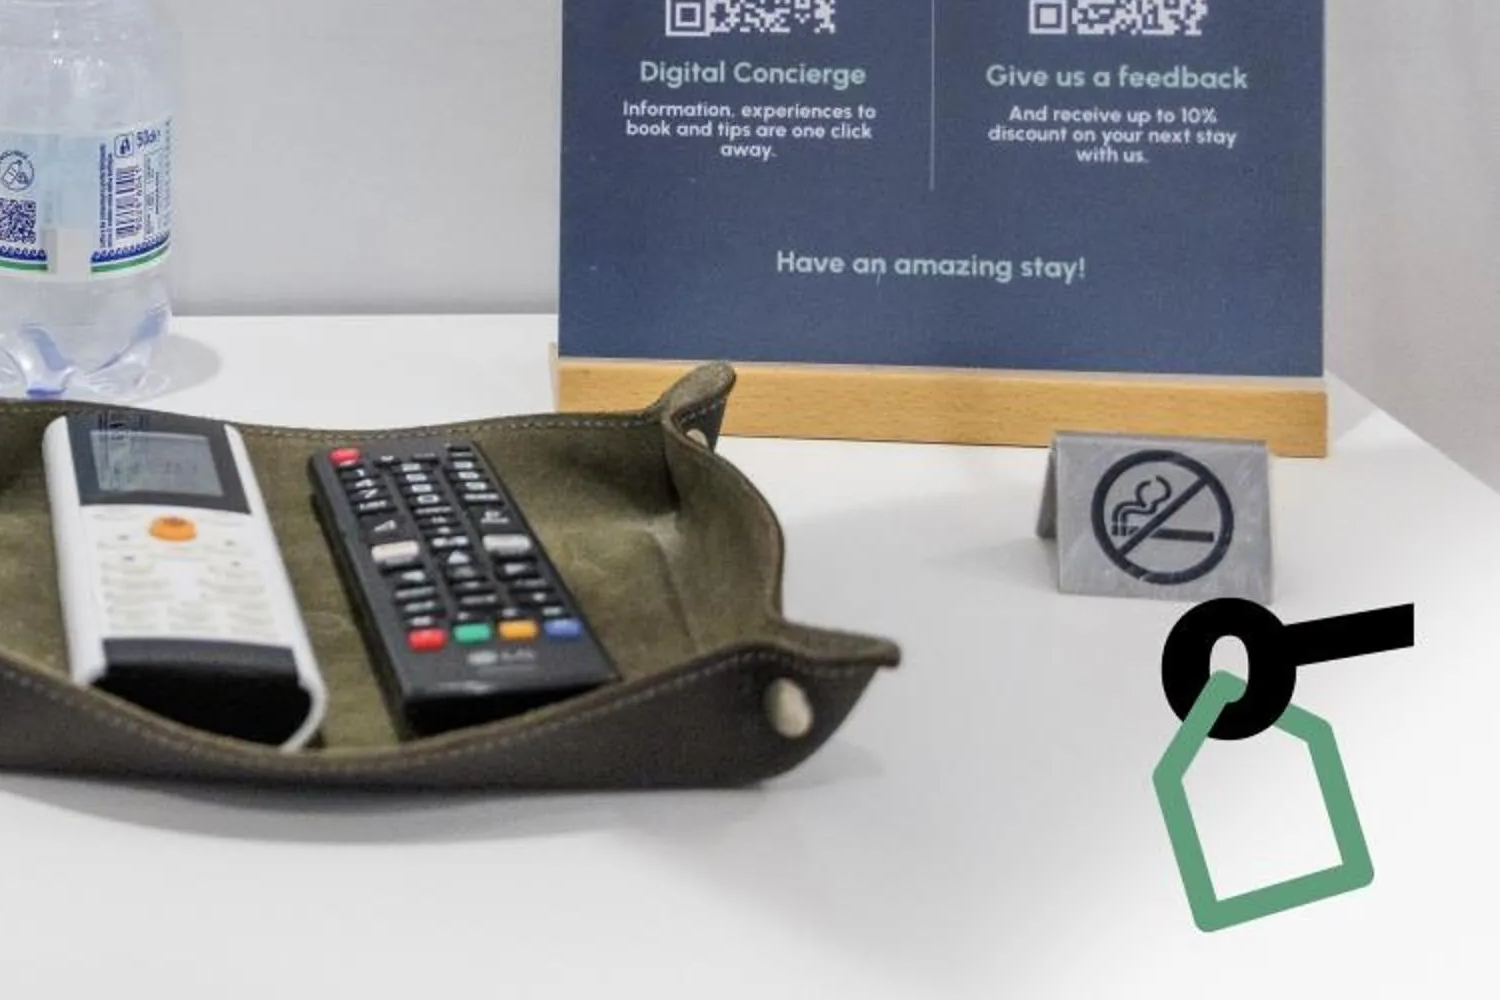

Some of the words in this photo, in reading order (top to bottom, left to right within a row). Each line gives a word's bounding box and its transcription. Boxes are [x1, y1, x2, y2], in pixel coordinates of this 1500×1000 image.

[639, 60, 727, 89] Digital
[732, 61, 867, 91] Concierge
[985, 64, 1049, 88] Give
[1056, 69, 1086, 88] us
[1093, 69, 1111, 88] a
[1117, 64, 1249, 89] feedback
[740, 103, 853, 123] experiences
[857, 104, 877, 120] to
[1008, 105, 1048, 122] And
[1052, 106, 1122, 123] receive
[1126, 110, 1152, 127] up
[1156, 107, 1176, 123] to
[1180, 107, 1218, 124] 10%
[626, 120, 671, 137] book
[676, 120, 713, 138] and
[717, 122, 751, 141] tips
[755, 125, 787, 139] are
[791, 125, 826, 139] one
[830, 122, 873, 139] click
[987, 124, 1068, 142] discount
[1072, 128, 1096, 143] on
[1100, 128, 1143, 147] your
[1147, 128, 1191, 144] next
[1196, 127, 1238, 149] stay
[720, 143, 778, 161] away.
[1075, 145, 1119, 163] with
[776, 250, 846, 274] Have
[852, 255, 887, 275] an
[893, 254, 1013, 284] amazing
[1019, 256, 1087, 285] stay!
